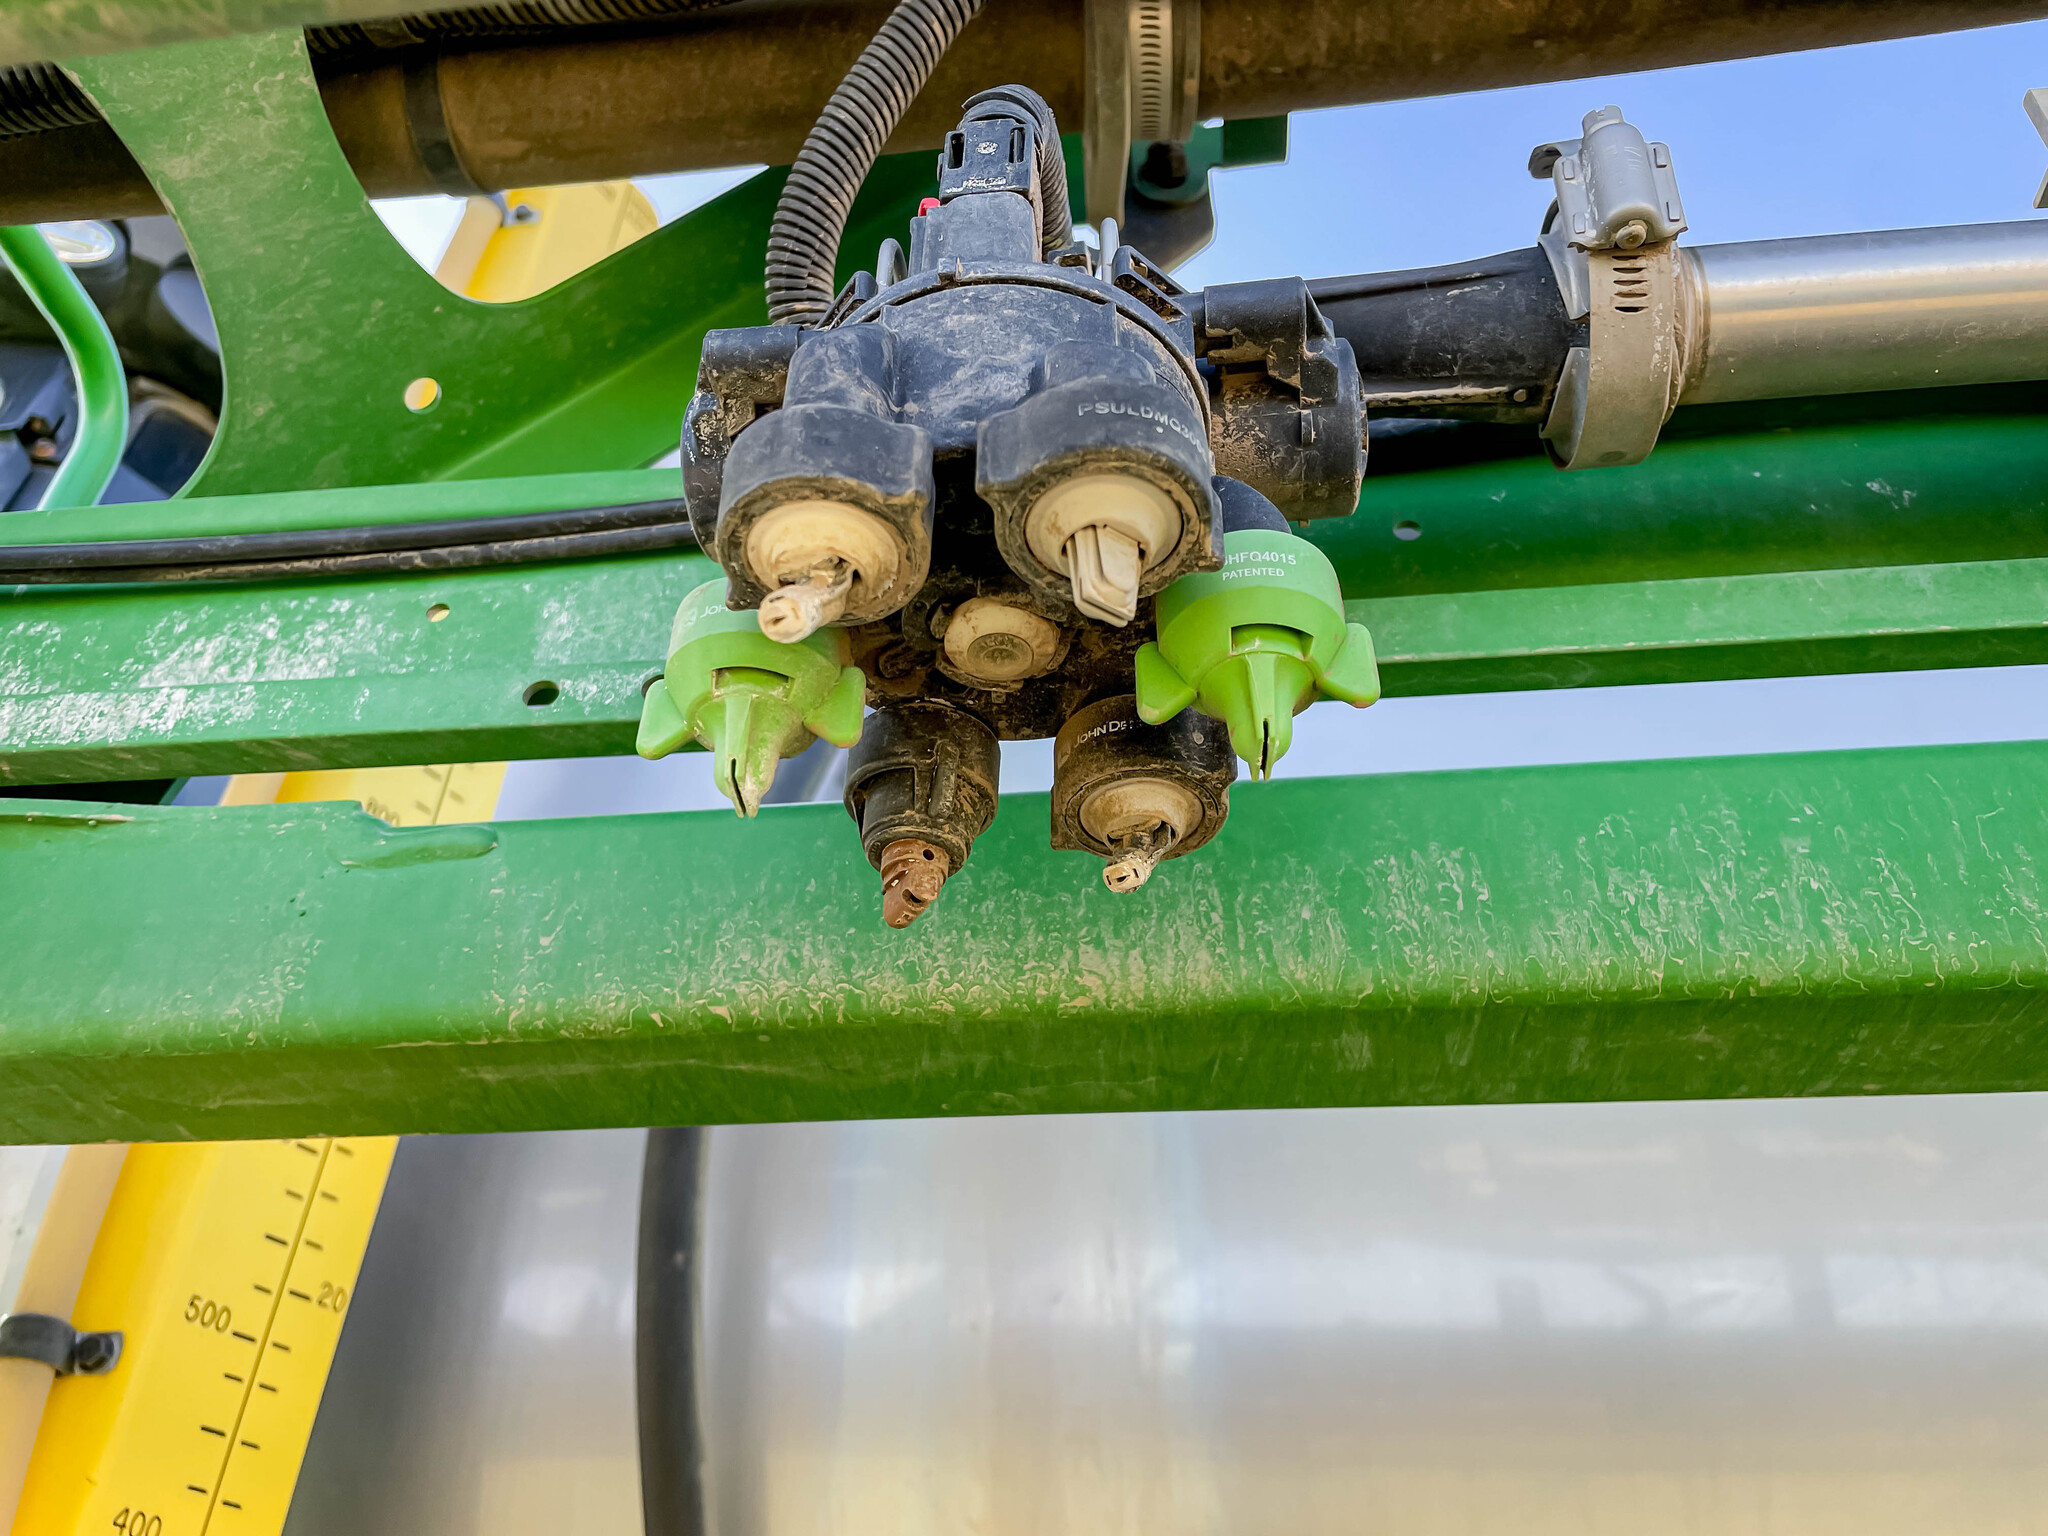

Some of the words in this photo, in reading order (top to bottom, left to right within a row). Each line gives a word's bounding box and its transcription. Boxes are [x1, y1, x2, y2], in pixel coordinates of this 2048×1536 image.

[1222, 567, 1285, 581] PATENTED
[700, 604, 729, 618] JOH
[1074, 724, 1107, 748] JOHN
[316, 1281, 348, 1313] 20
[184, 1294, 232, 1333] 500
[112, 1507, 162, 1536] 400
